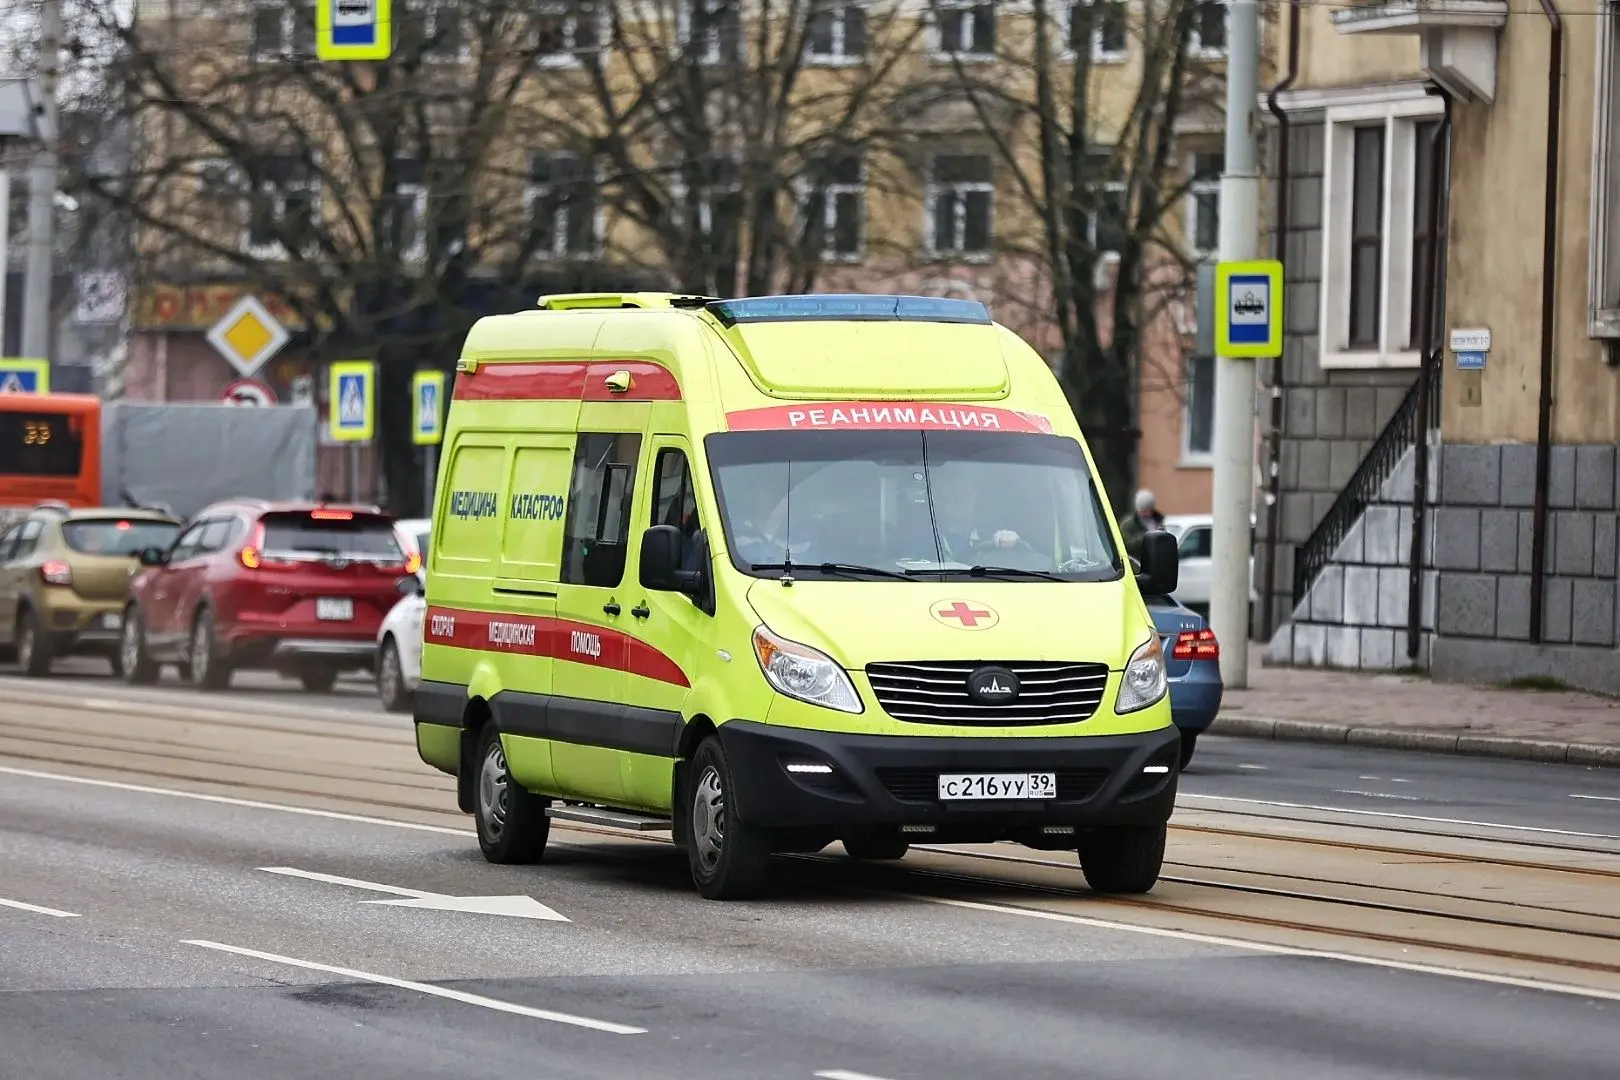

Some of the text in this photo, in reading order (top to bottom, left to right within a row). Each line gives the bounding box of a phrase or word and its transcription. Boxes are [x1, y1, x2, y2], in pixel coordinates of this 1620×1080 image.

[787, 407, 1001, 429] РЕАНИМАЦИЯ
[450, 491, 564, 521] МЕДИЦИНА КАТАСТРОФ
[431, 614, 601, 660] СКОРАЯ МЕДИЦИНСКАЯ ПОМОЩЬ
[1030, 775, 1050, 790] 39
